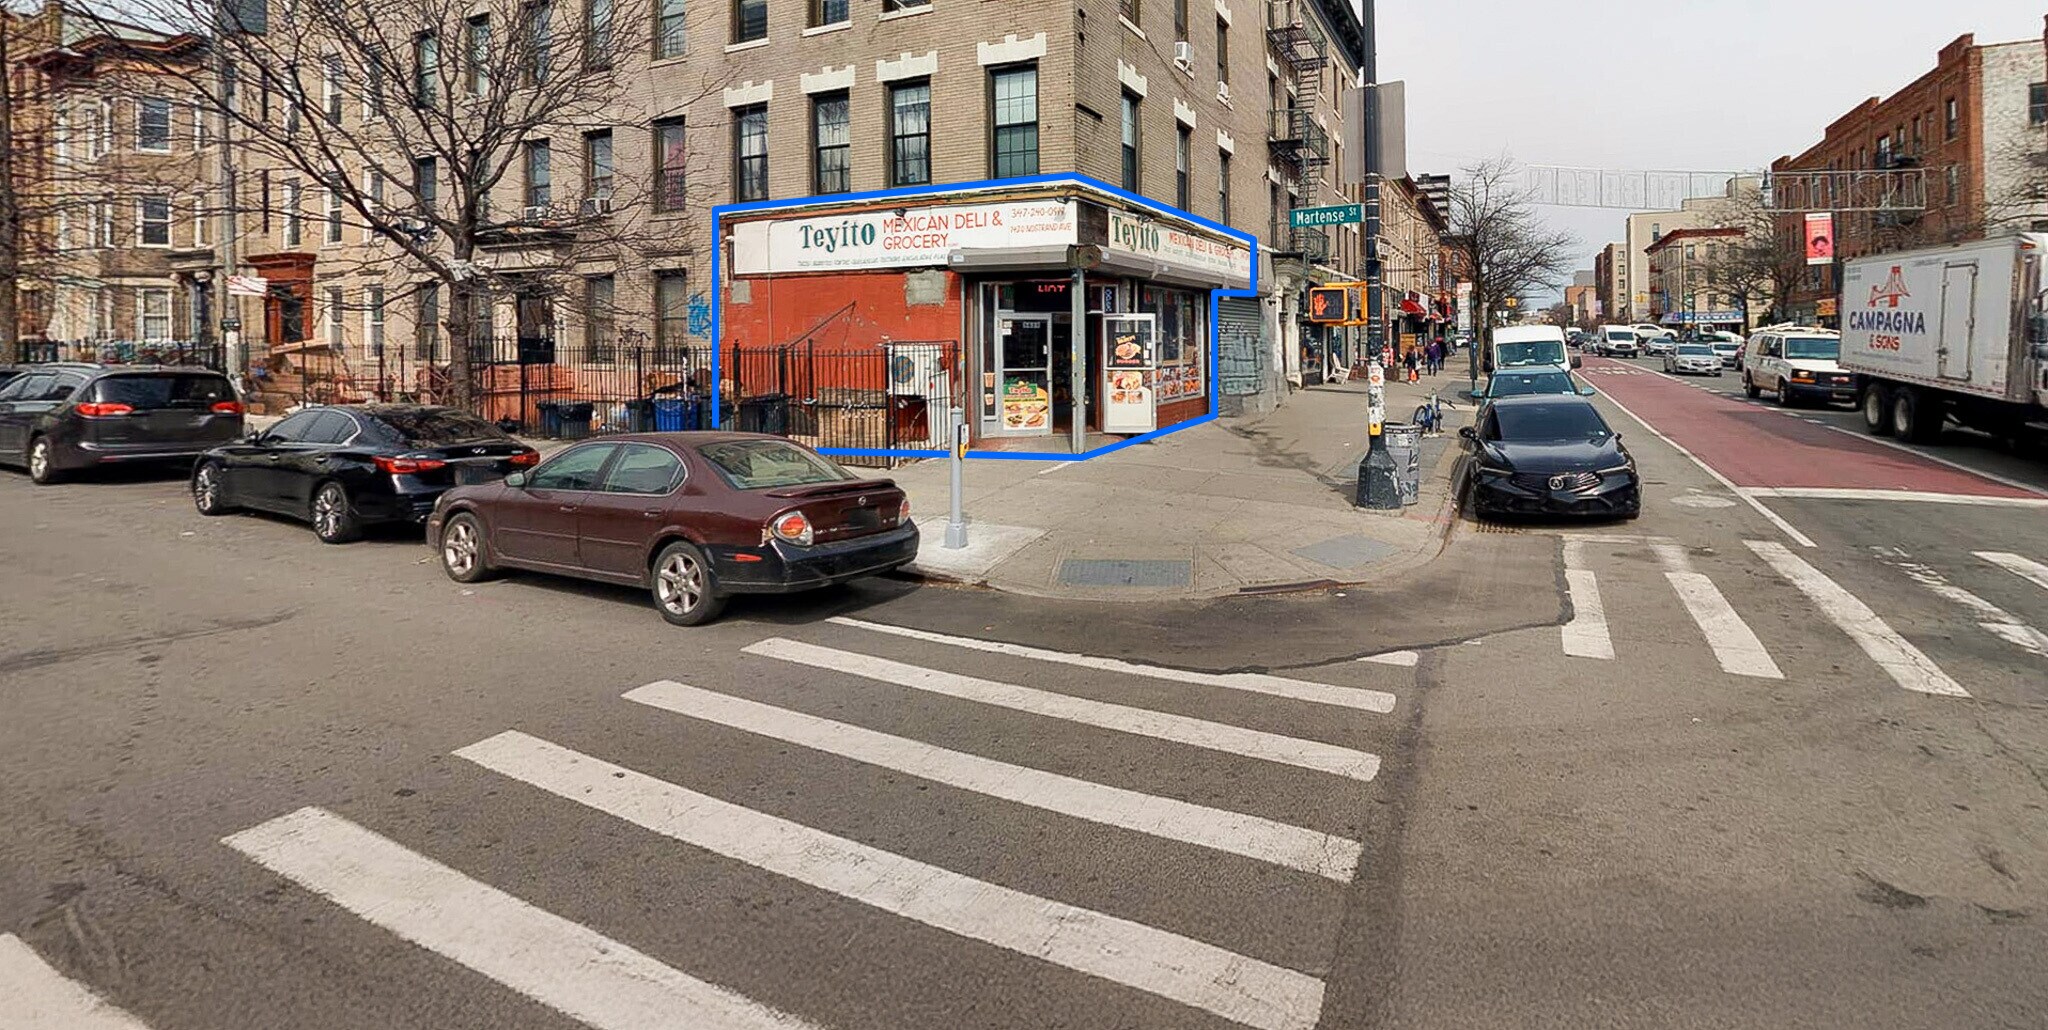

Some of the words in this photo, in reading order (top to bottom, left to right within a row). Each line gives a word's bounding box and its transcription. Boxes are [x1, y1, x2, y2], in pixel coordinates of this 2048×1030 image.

[883, 214, 949, 234] MEXICAN
[955, 211, 987, 230] DELI
[992, 210, 1003, 227] &
[1296, 210, 1345, 225] Martense
[1348, 206, 1357, 217] St
[883, 232, 949, 250] GROCERY
[1849, 311, 1926, 335] CAMPAGNA
[1875, 334, 1900, 352] SONS
